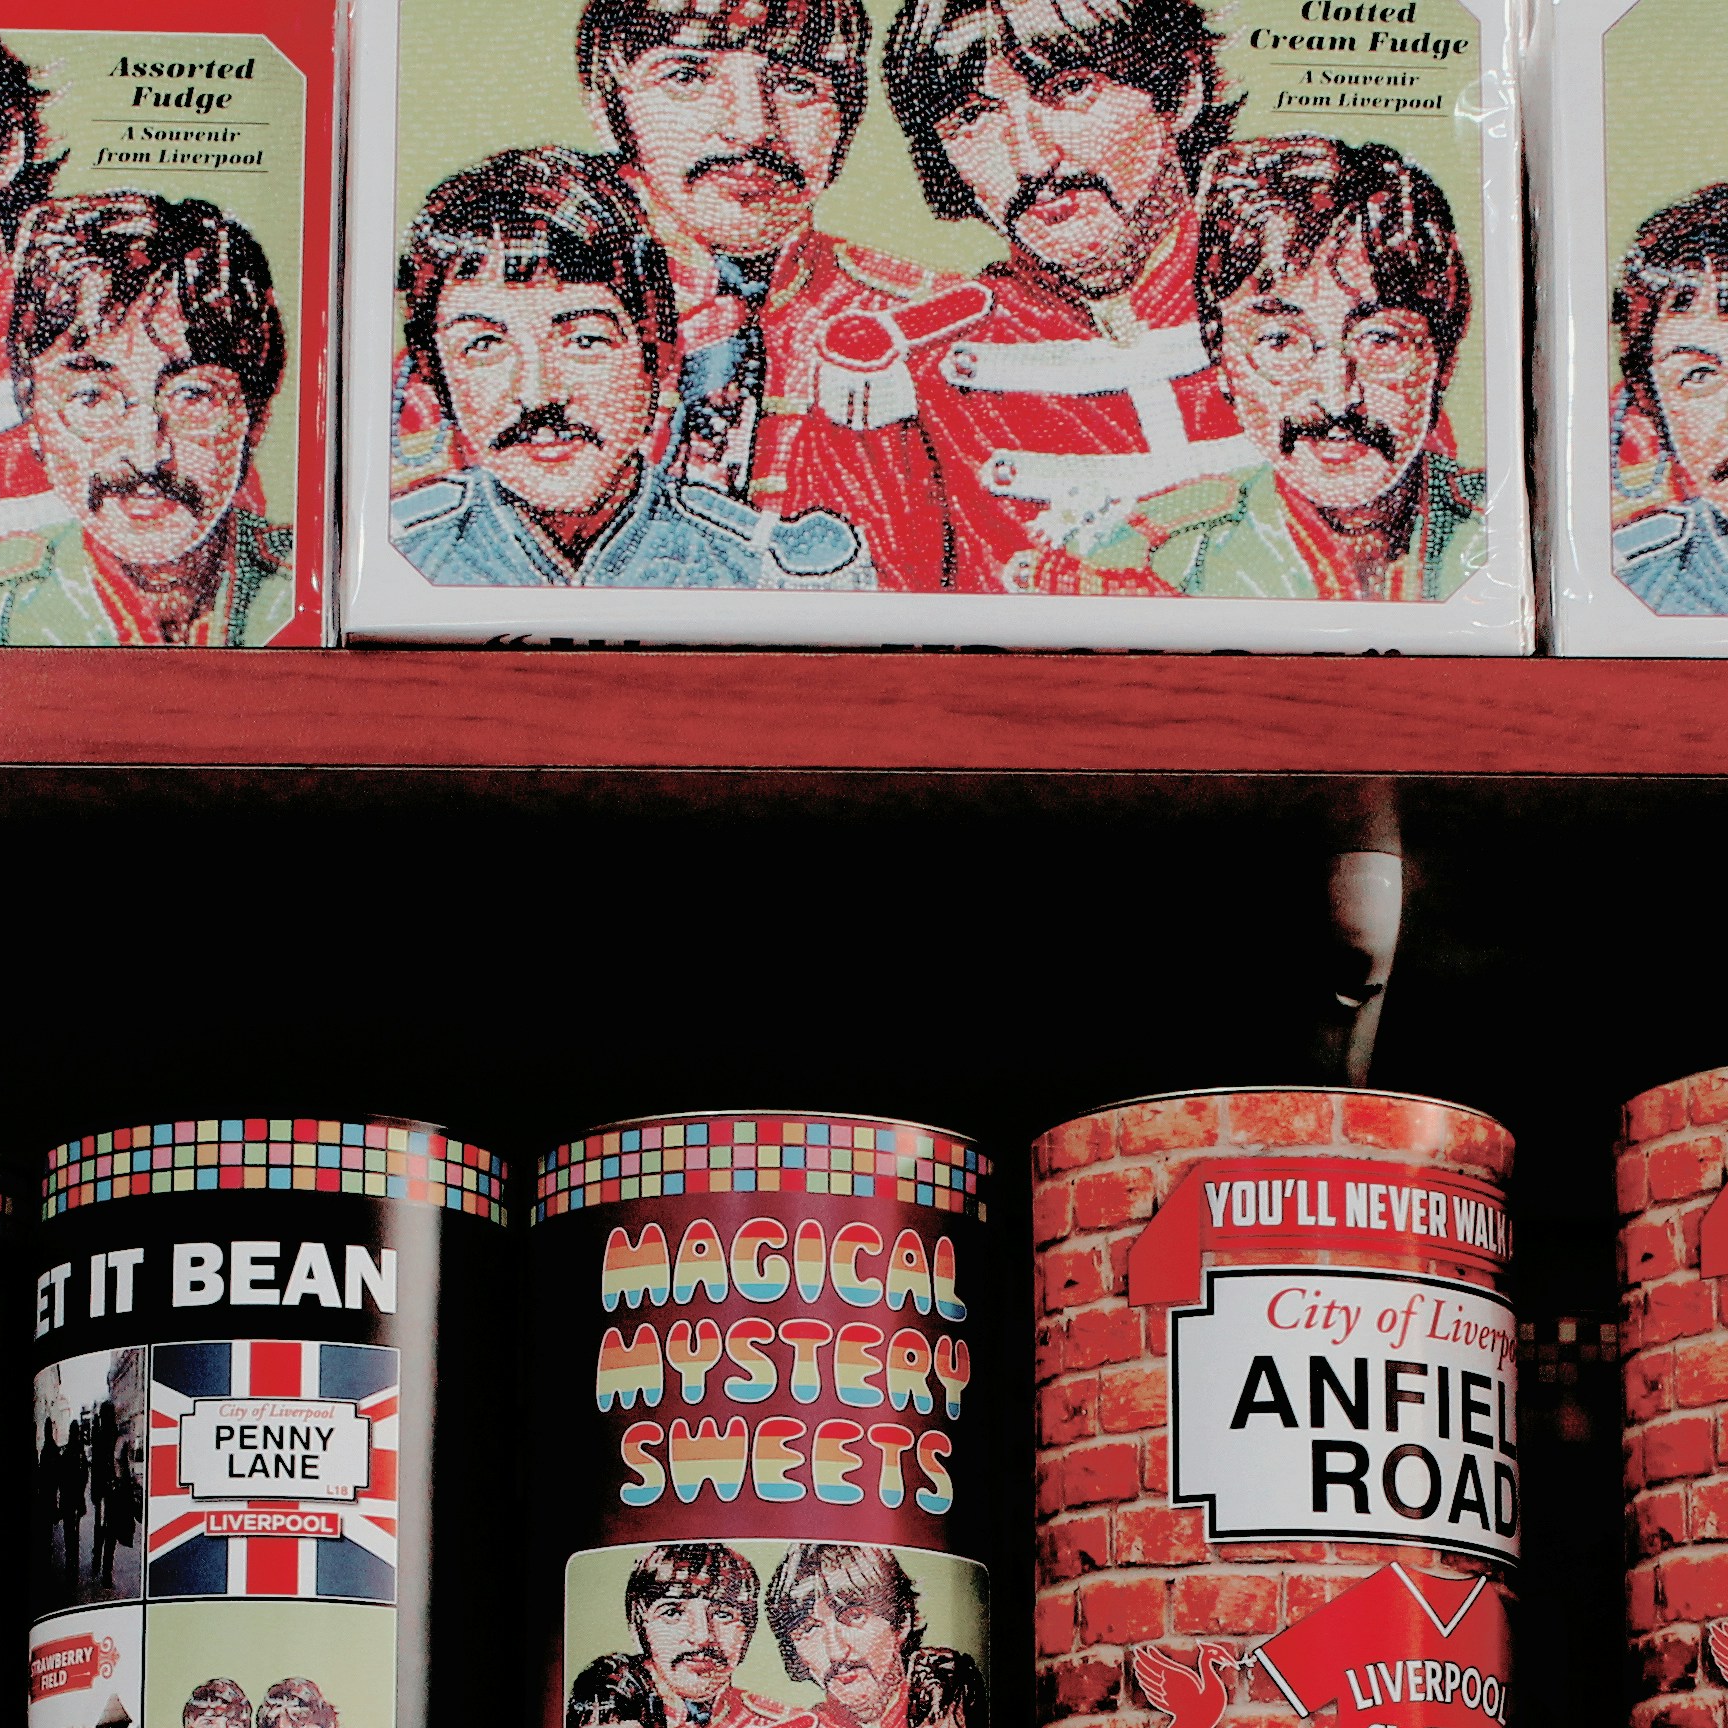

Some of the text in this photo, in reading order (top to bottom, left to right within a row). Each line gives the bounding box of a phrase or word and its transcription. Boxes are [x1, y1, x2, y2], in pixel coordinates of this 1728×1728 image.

[1301, 0, 1417, 23] Clotted
[1250, 28, 1469, 60] Cream Fudge
[108, 57, 255, 79] Assorted
[1299, 70, 1419, 86] A Souvenir
[132, 86, 232, 114] Fudge
[1274, 91, 1442, 111] from Liverpool
[121, 127, 241, 142] A Souvenir
[93, 148, 263, 168] from Liverpool
[1346, 1181, 1448, 1238] NEVER
[90, 1241, 397, 1318] IT BEAN
[602, 1217, 967, 1321] MAGICAL
[1267, 1287, 1424, 1348] City of
[596, 1318, 970, 1420] MYSTERY
[219, 1403, 336, 1421] City of Liverpool
[215, 1426, 335, 1452] PENNY
[228, 1454, 319, 1480] LANE
[620, 1416, 952, 1514] SWEETS
[326, 1485, 349, 1496] L18
[1312, 1440, 1518, 1540] ROAD
[209, 1514, 333, 1533] LIVERPOOL
[41, 1670, 67, 1691] FIELD
[1345, 1659, 1507, 1726] LIVERPOOL
